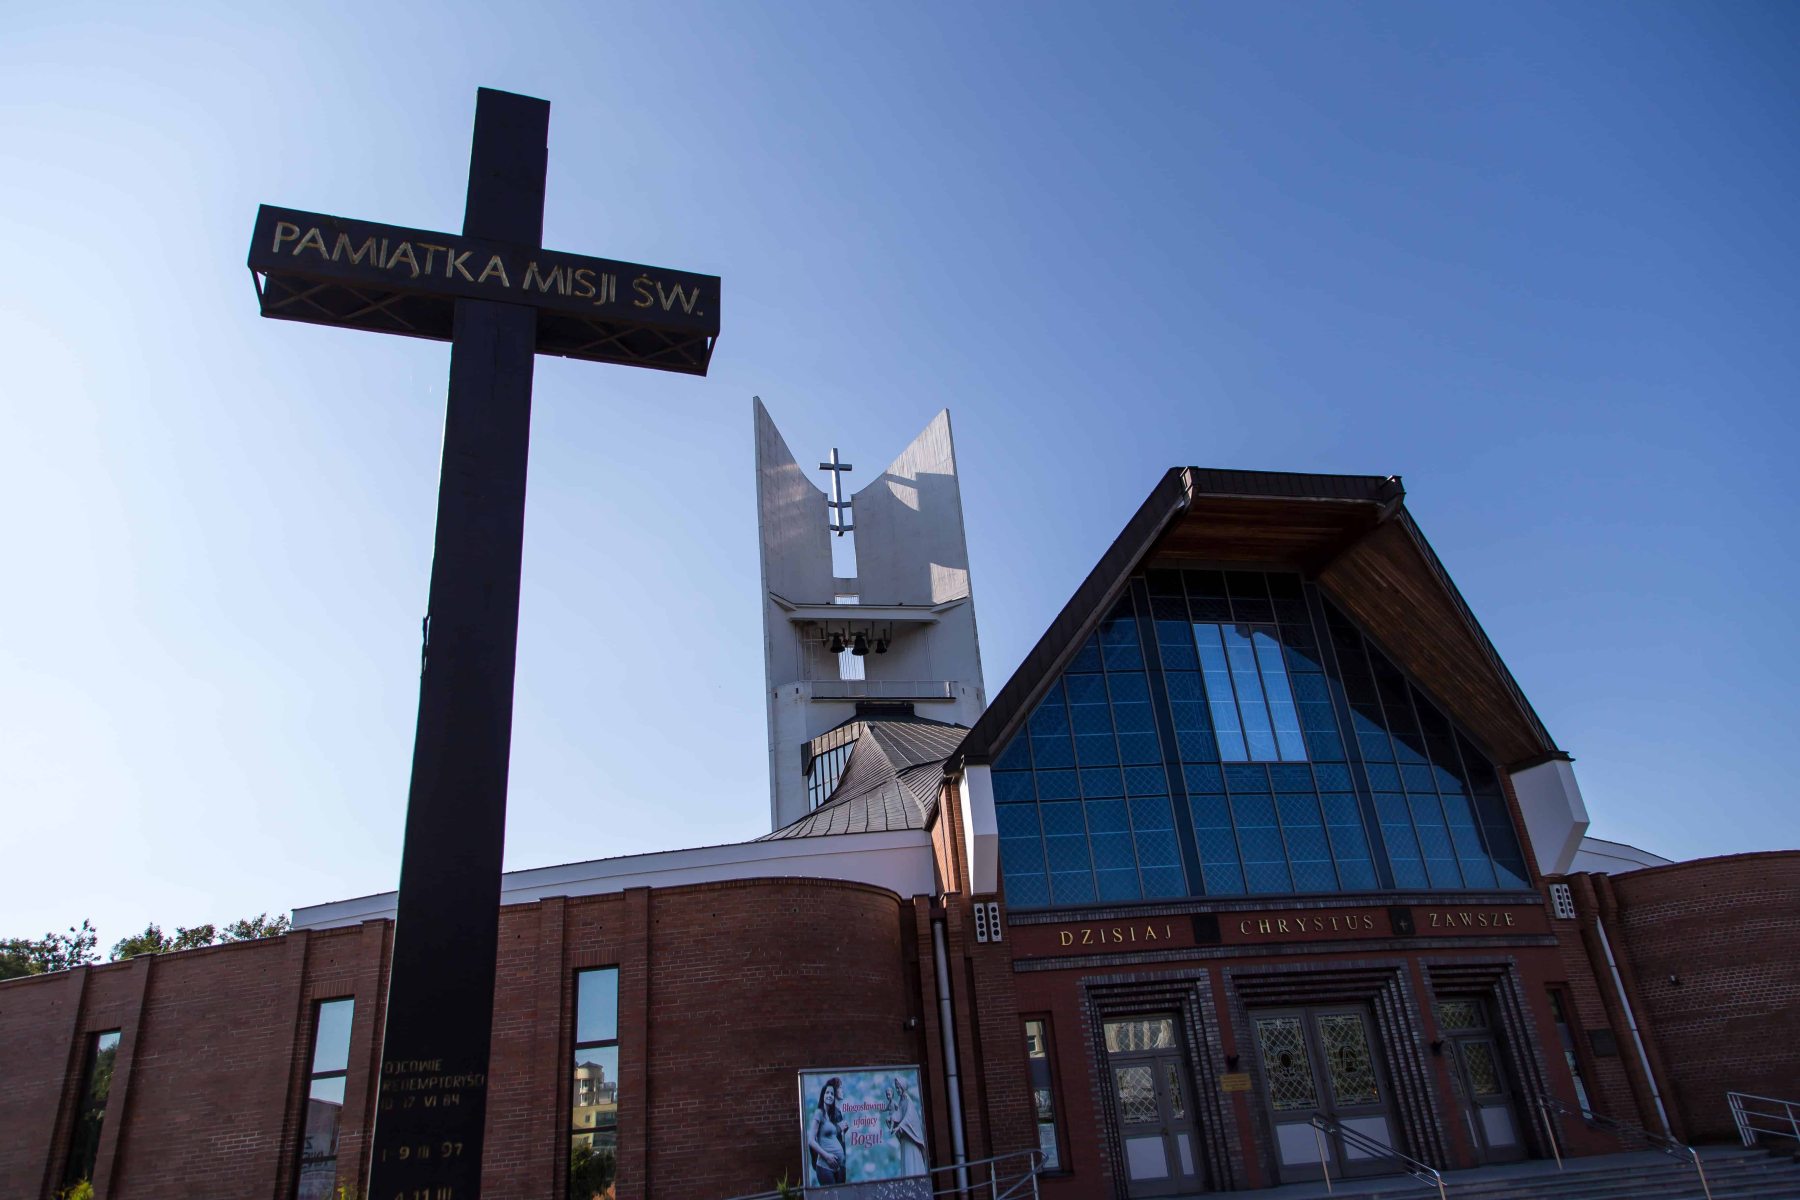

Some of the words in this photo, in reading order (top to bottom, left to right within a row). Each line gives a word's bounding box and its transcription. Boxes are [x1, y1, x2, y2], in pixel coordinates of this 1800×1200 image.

[272, 222, 510, 287] PAMIĄTKA
[523, 261, 616, 306] MISJI
[632, 272, 704, 315] ŚW.
[1061, 925, 1172, 946] DZISIAJ
[1239, 914, 1375, 936] CHRYSTUS
[1430, 912, 1515, 927] ZAWSZE
[384, 1059, 443, 1074] OJCOWIE
[424, 1095, 437, 1107] VI
[851, 1129, 882, 1149] Bogu!
